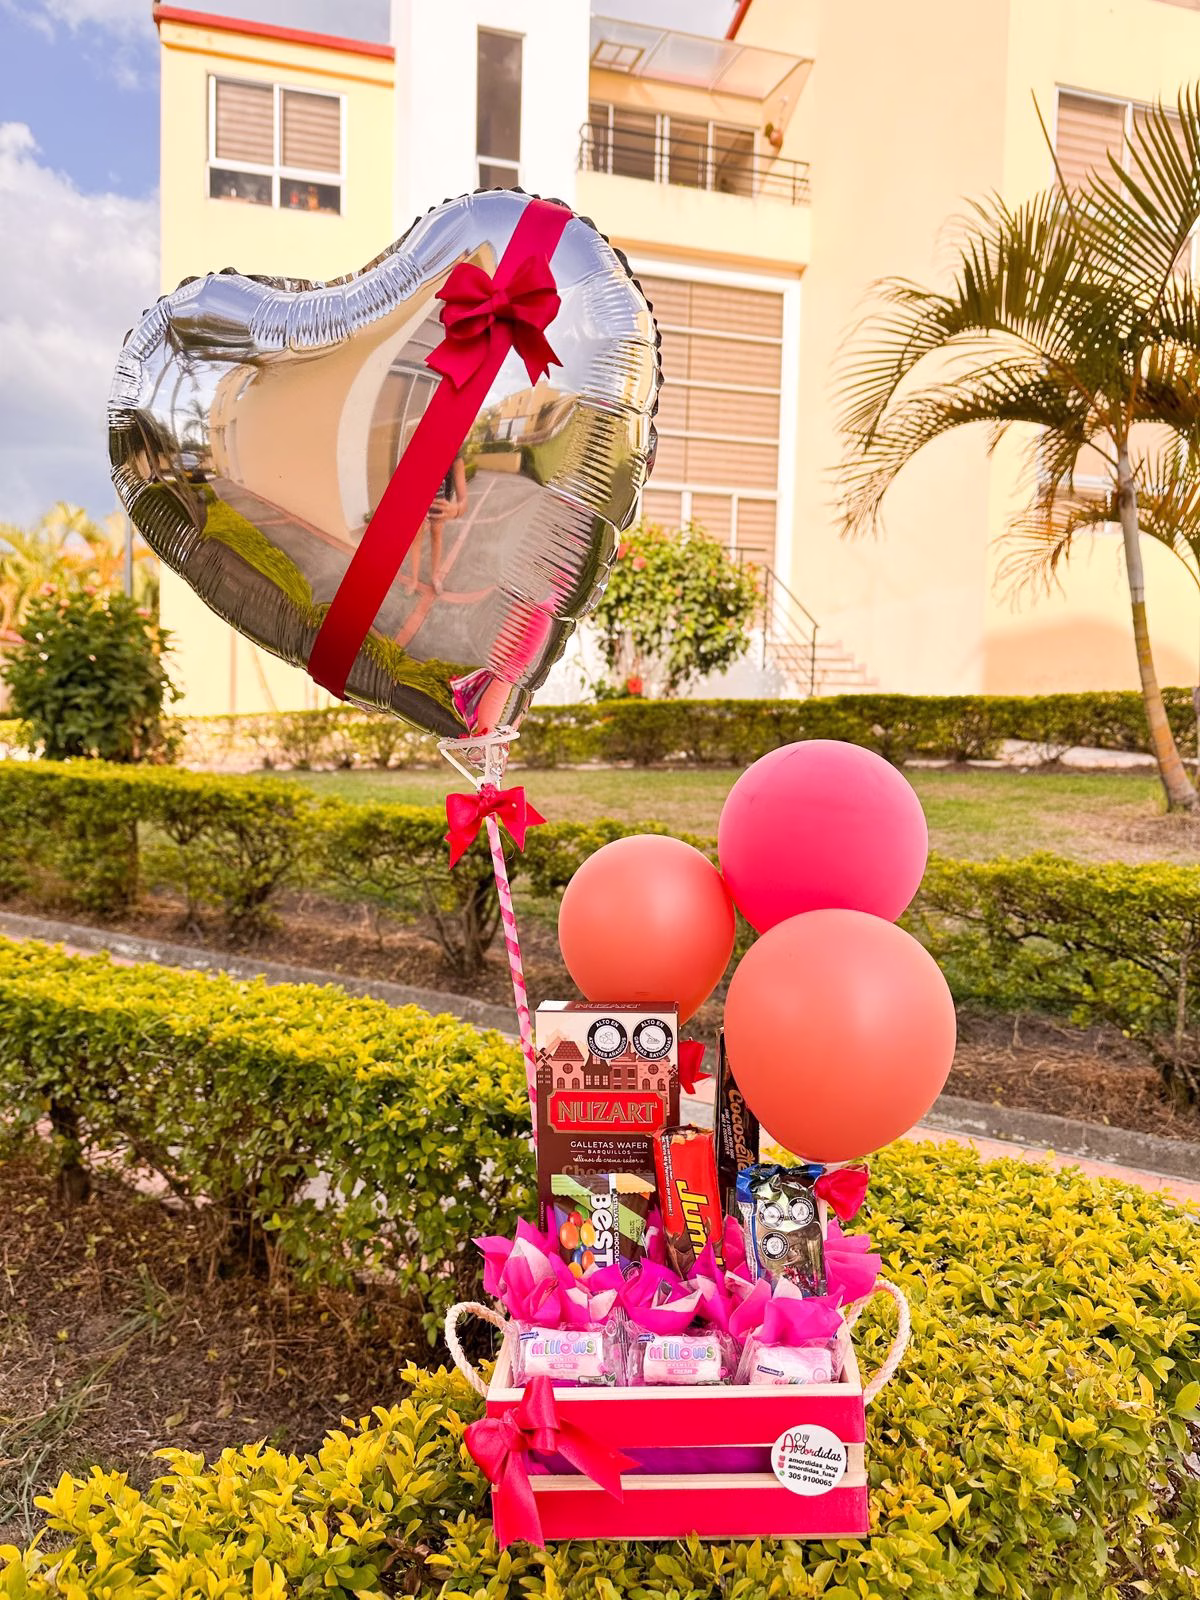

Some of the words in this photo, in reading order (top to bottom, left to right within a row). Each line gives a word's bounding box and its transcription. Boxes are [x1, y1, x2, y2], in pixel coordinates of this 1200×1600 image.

[596, 1020, 610, 1028] ALTO
[641, 1020, 655, 1028] ALTO
[557, 1100, 658, 1124] NUZART
[570, 1140, 614, 1150] GALLETAS
[616, 1141, 649, 1150] WAFER
[531, 1339, 596, 1356] millows
[650, 1342, 715, 1361] millows
[788, 1457, 839, 1473] amordidas_bog
[788, 1464, 836, 1478] amordidas_fusa
[788, 1471, 801, 1481] 305
[803, 1475, 833, 1487] 9100065
